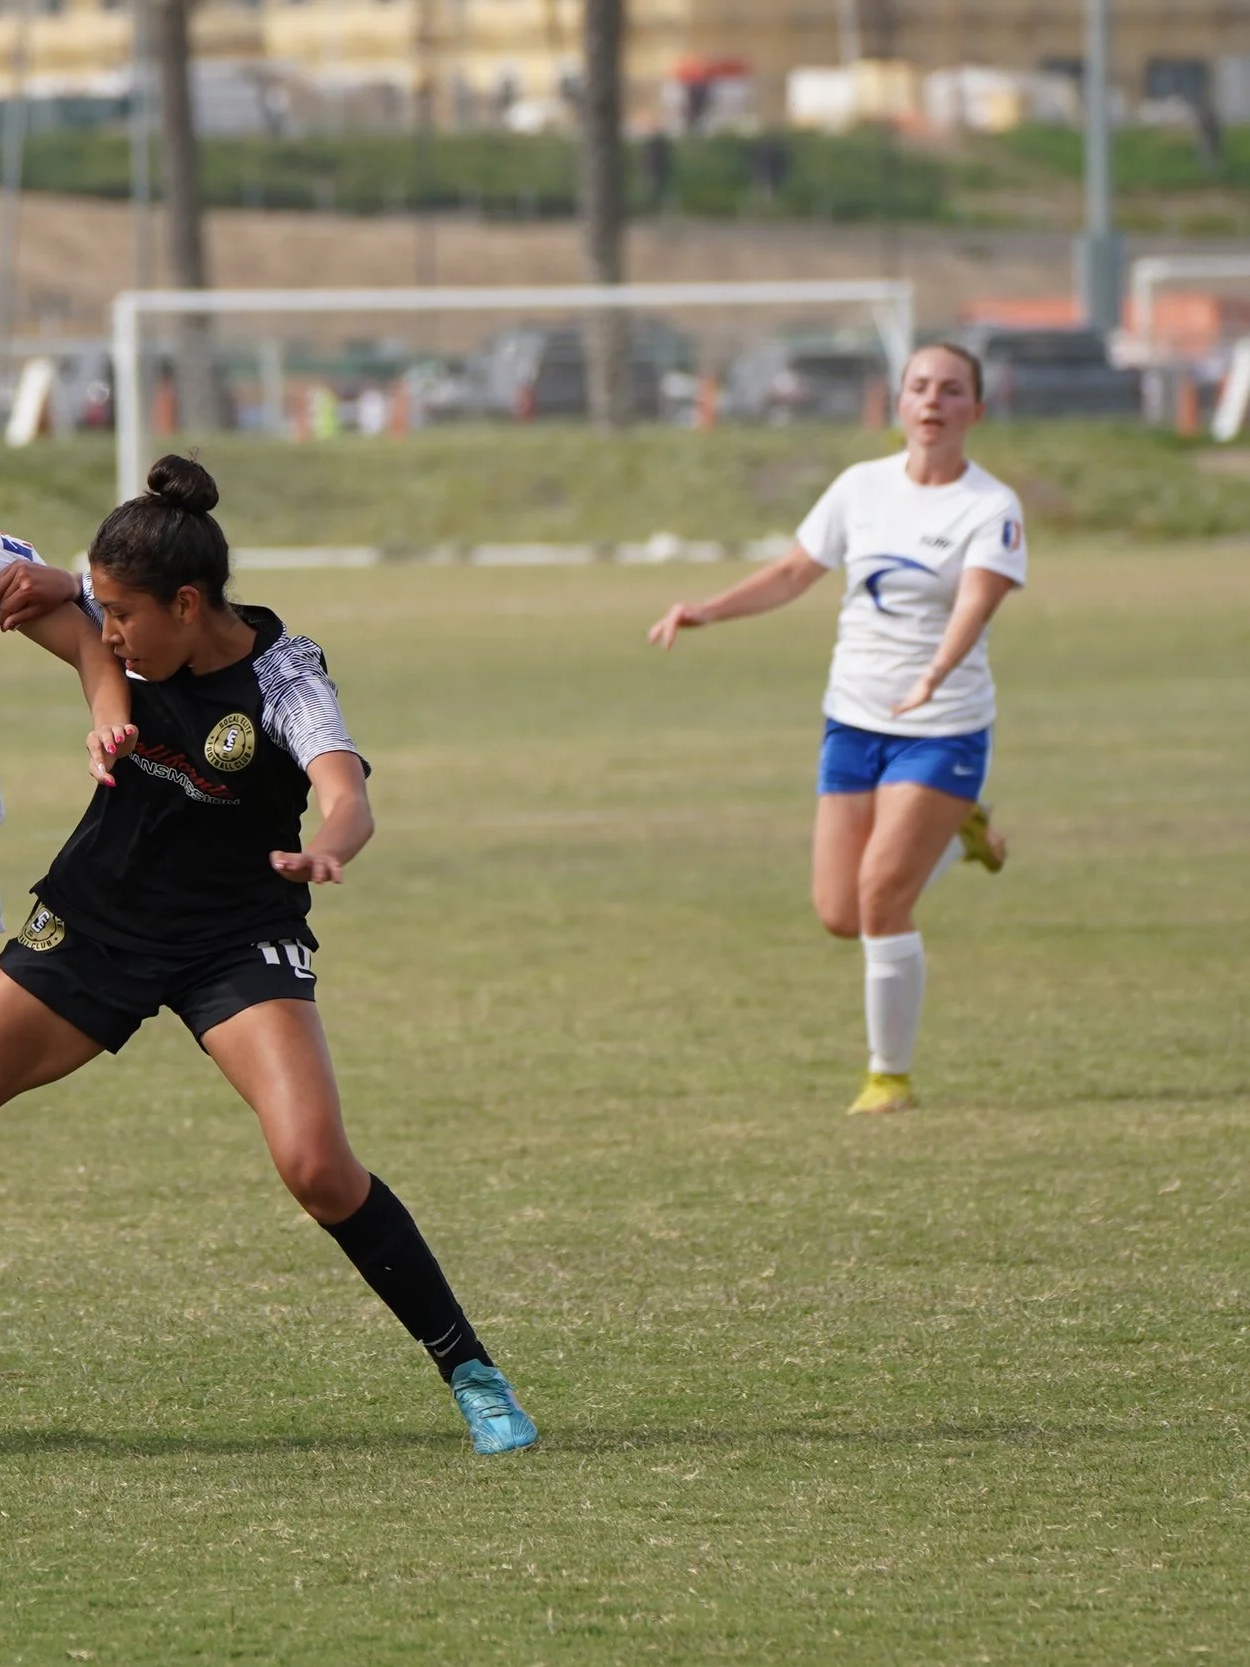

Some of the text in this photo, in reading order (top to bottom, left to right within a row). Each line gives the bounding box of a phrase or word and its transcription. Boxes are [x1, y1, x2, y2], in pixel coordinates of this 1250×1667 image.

[219, 715, 252, 736] SOCAL ELITE
[206, 742, 251, 770] FOOTBALL CLUB
